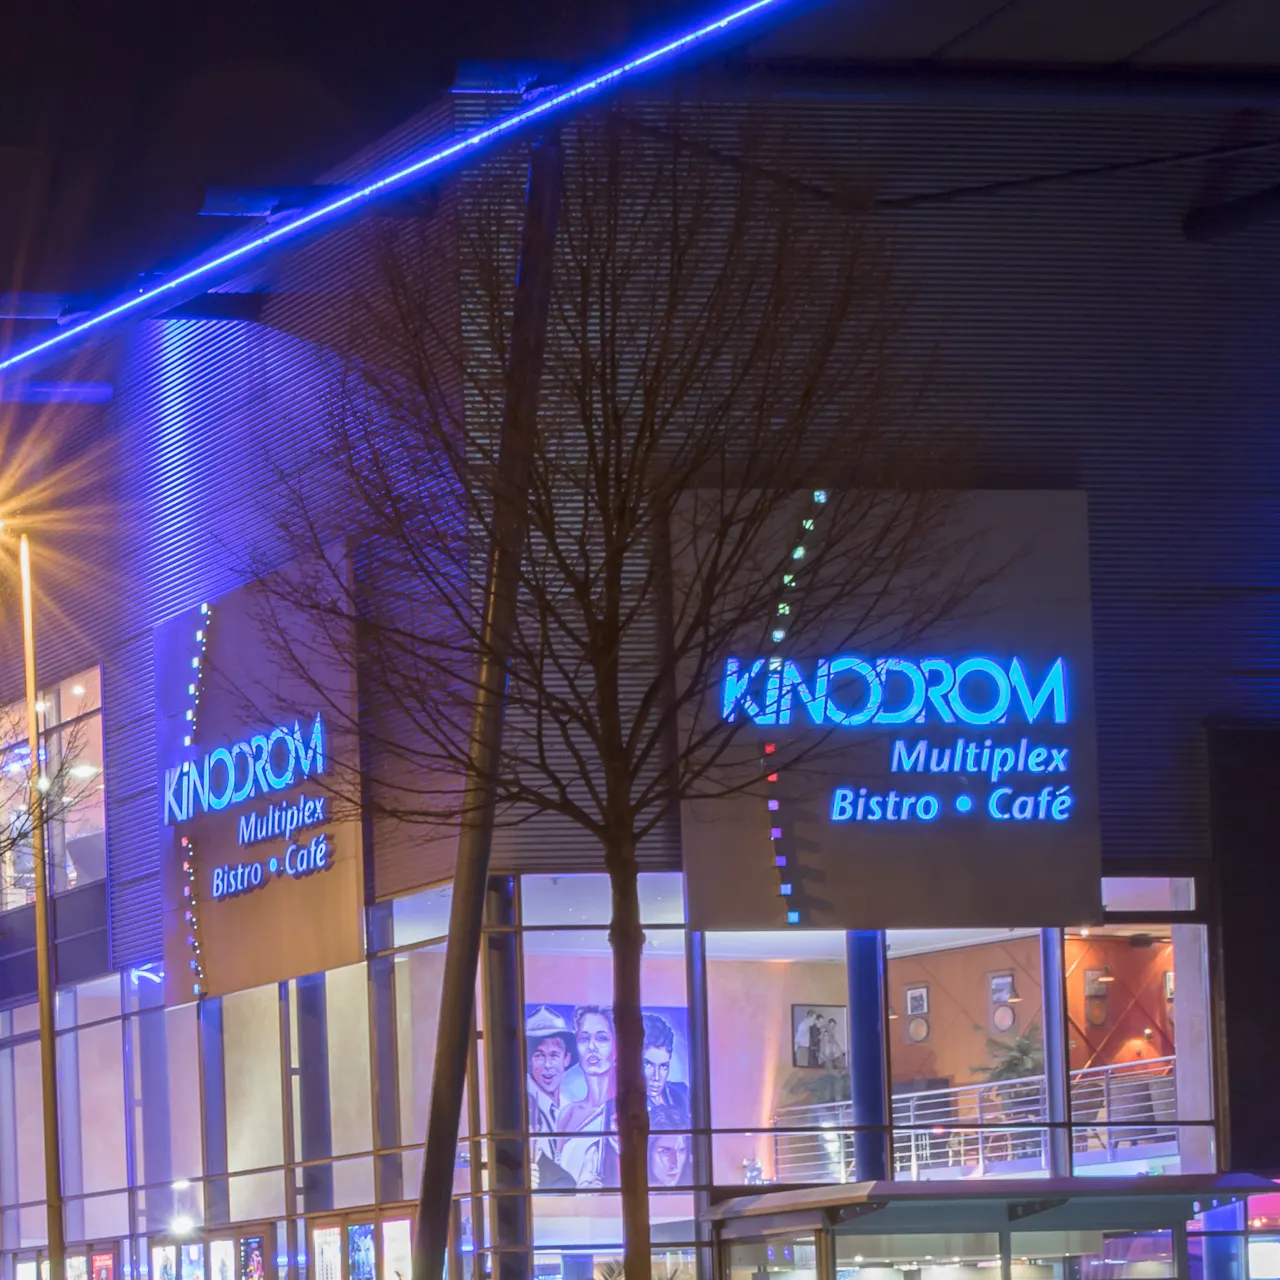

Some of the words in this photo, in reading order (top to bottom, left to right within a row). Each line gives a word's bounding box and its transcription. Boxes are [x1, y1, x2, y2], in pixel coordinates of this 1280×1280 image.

[721, 656, 1069, 726] KINODROM
[891, 739, 1069, 782] Multiplex
[239, 795, 325, 845] Multiplex
[831, 789, 939, 821] Bistro
[988, 786, 1071, 821] Café
[212, 862, 261, 897] Bistro
[286, 834, 326, 875] Café
